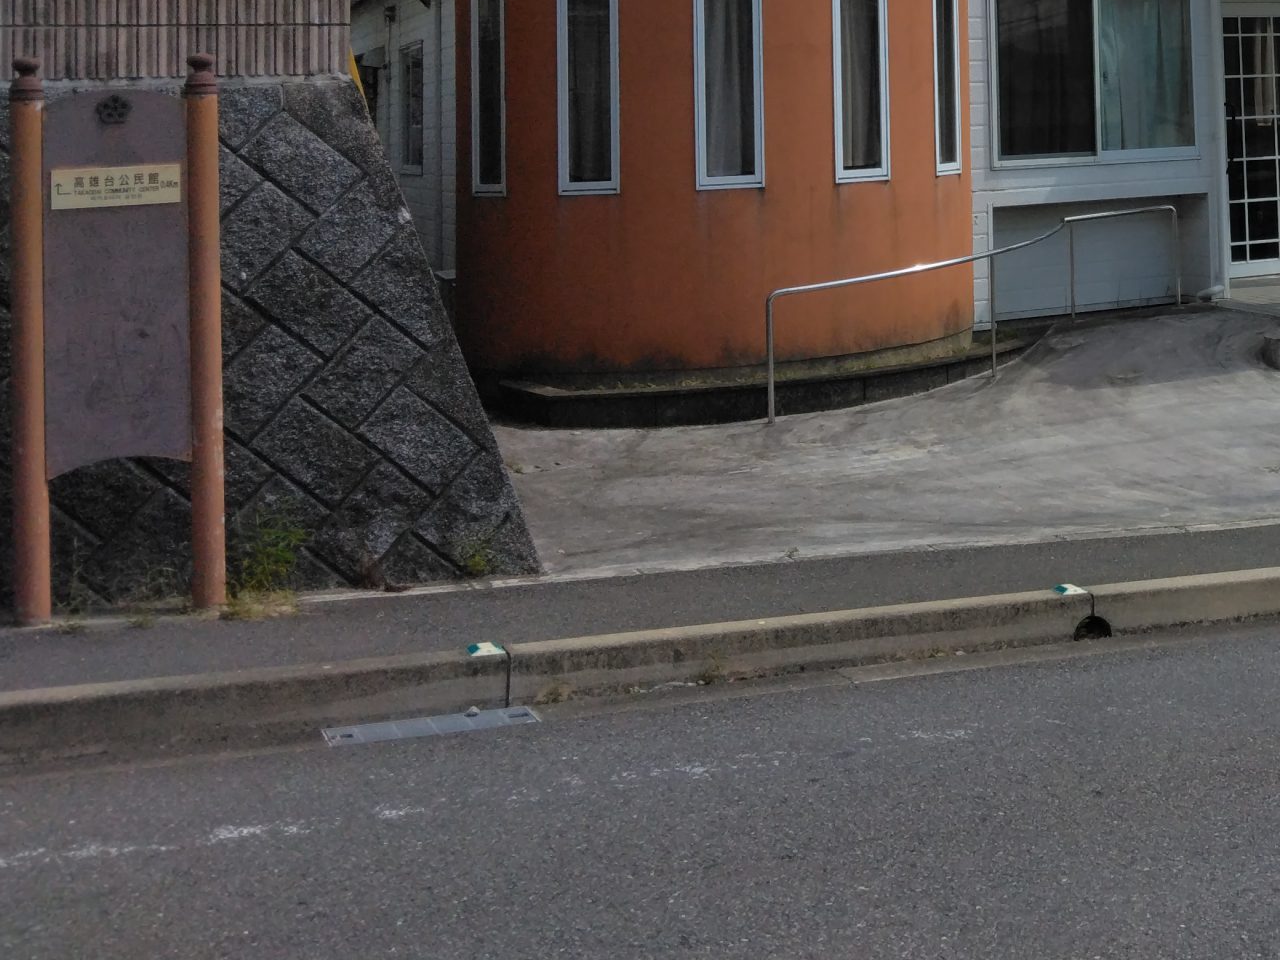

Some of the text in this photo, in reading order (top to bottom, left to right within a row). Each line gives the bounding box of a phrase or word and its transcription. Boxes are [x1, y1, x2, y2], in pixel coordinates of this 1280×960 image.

[74, 173, 160, 188] 高雄台公民館
